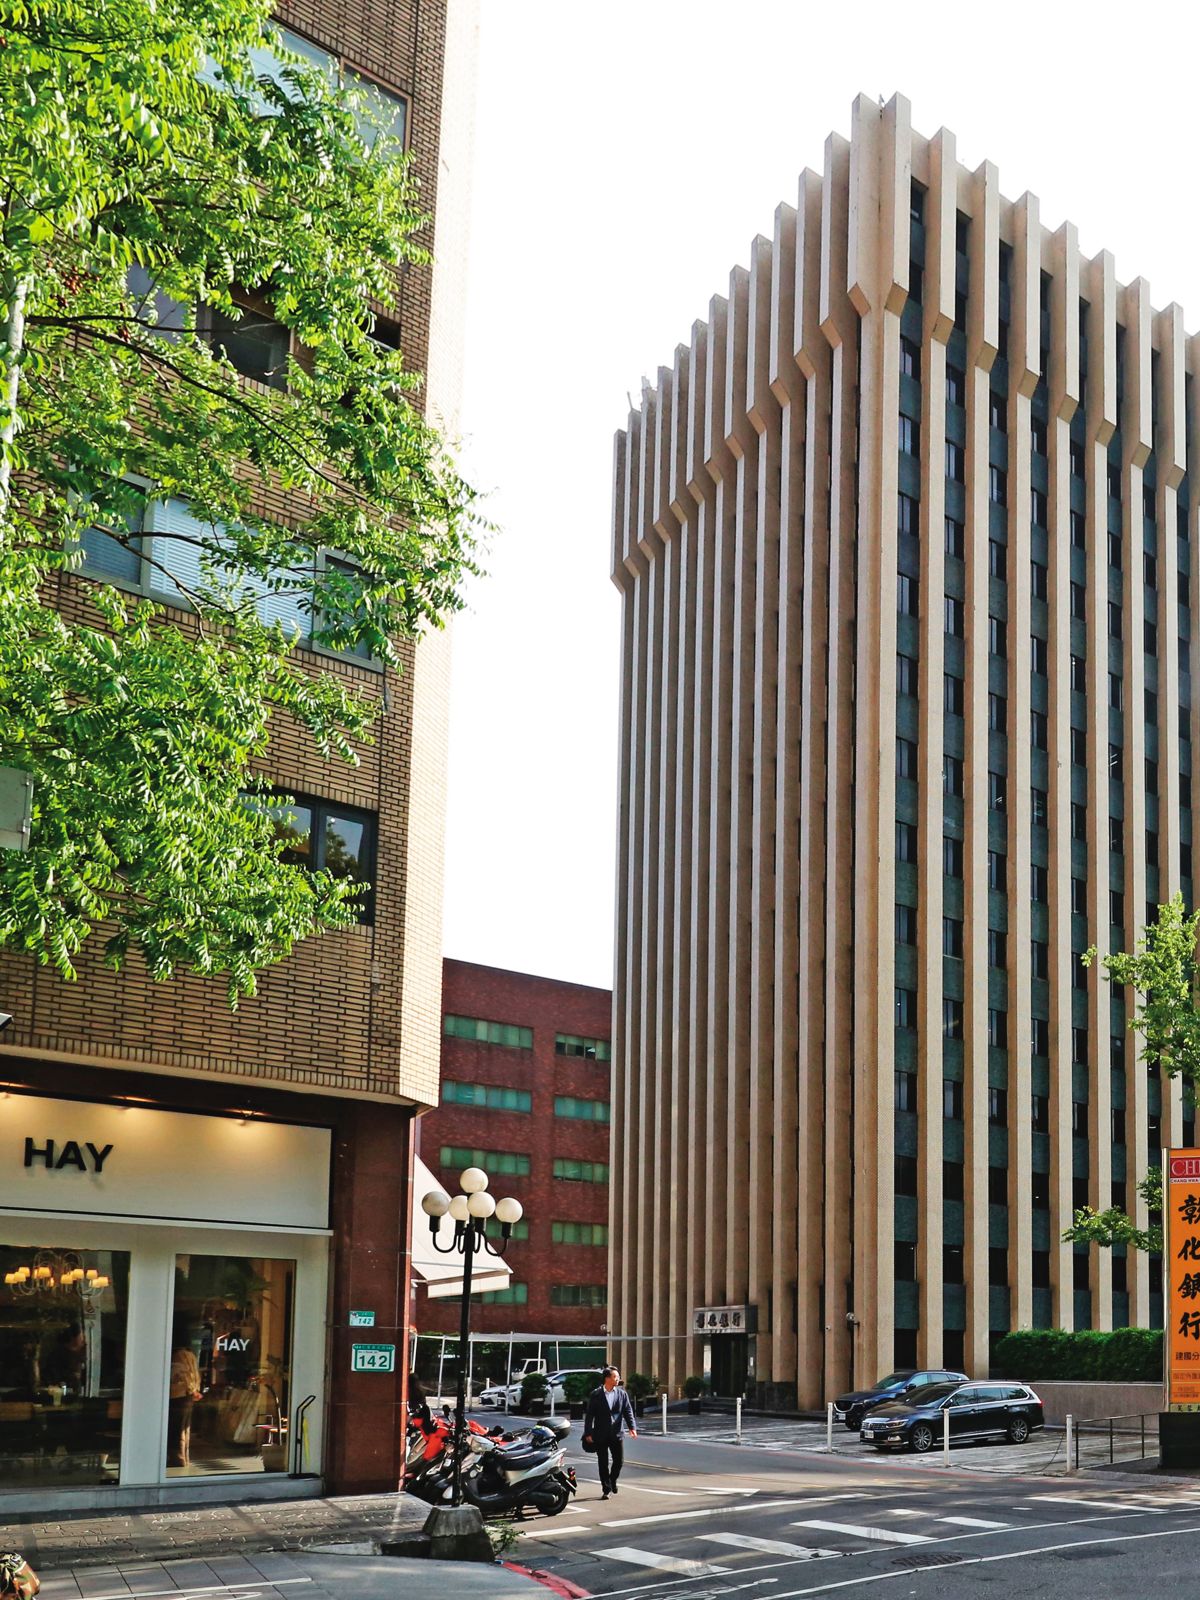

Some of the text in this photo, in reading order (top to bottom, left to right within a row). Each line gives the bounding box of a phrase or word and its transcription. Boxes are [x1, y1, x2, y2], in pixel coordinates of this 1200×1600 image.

[24, 1137, 114, 1173] HAY
[216, 1338, 250, 1351] HAY
[358, 1355, 388, 1367] 142
